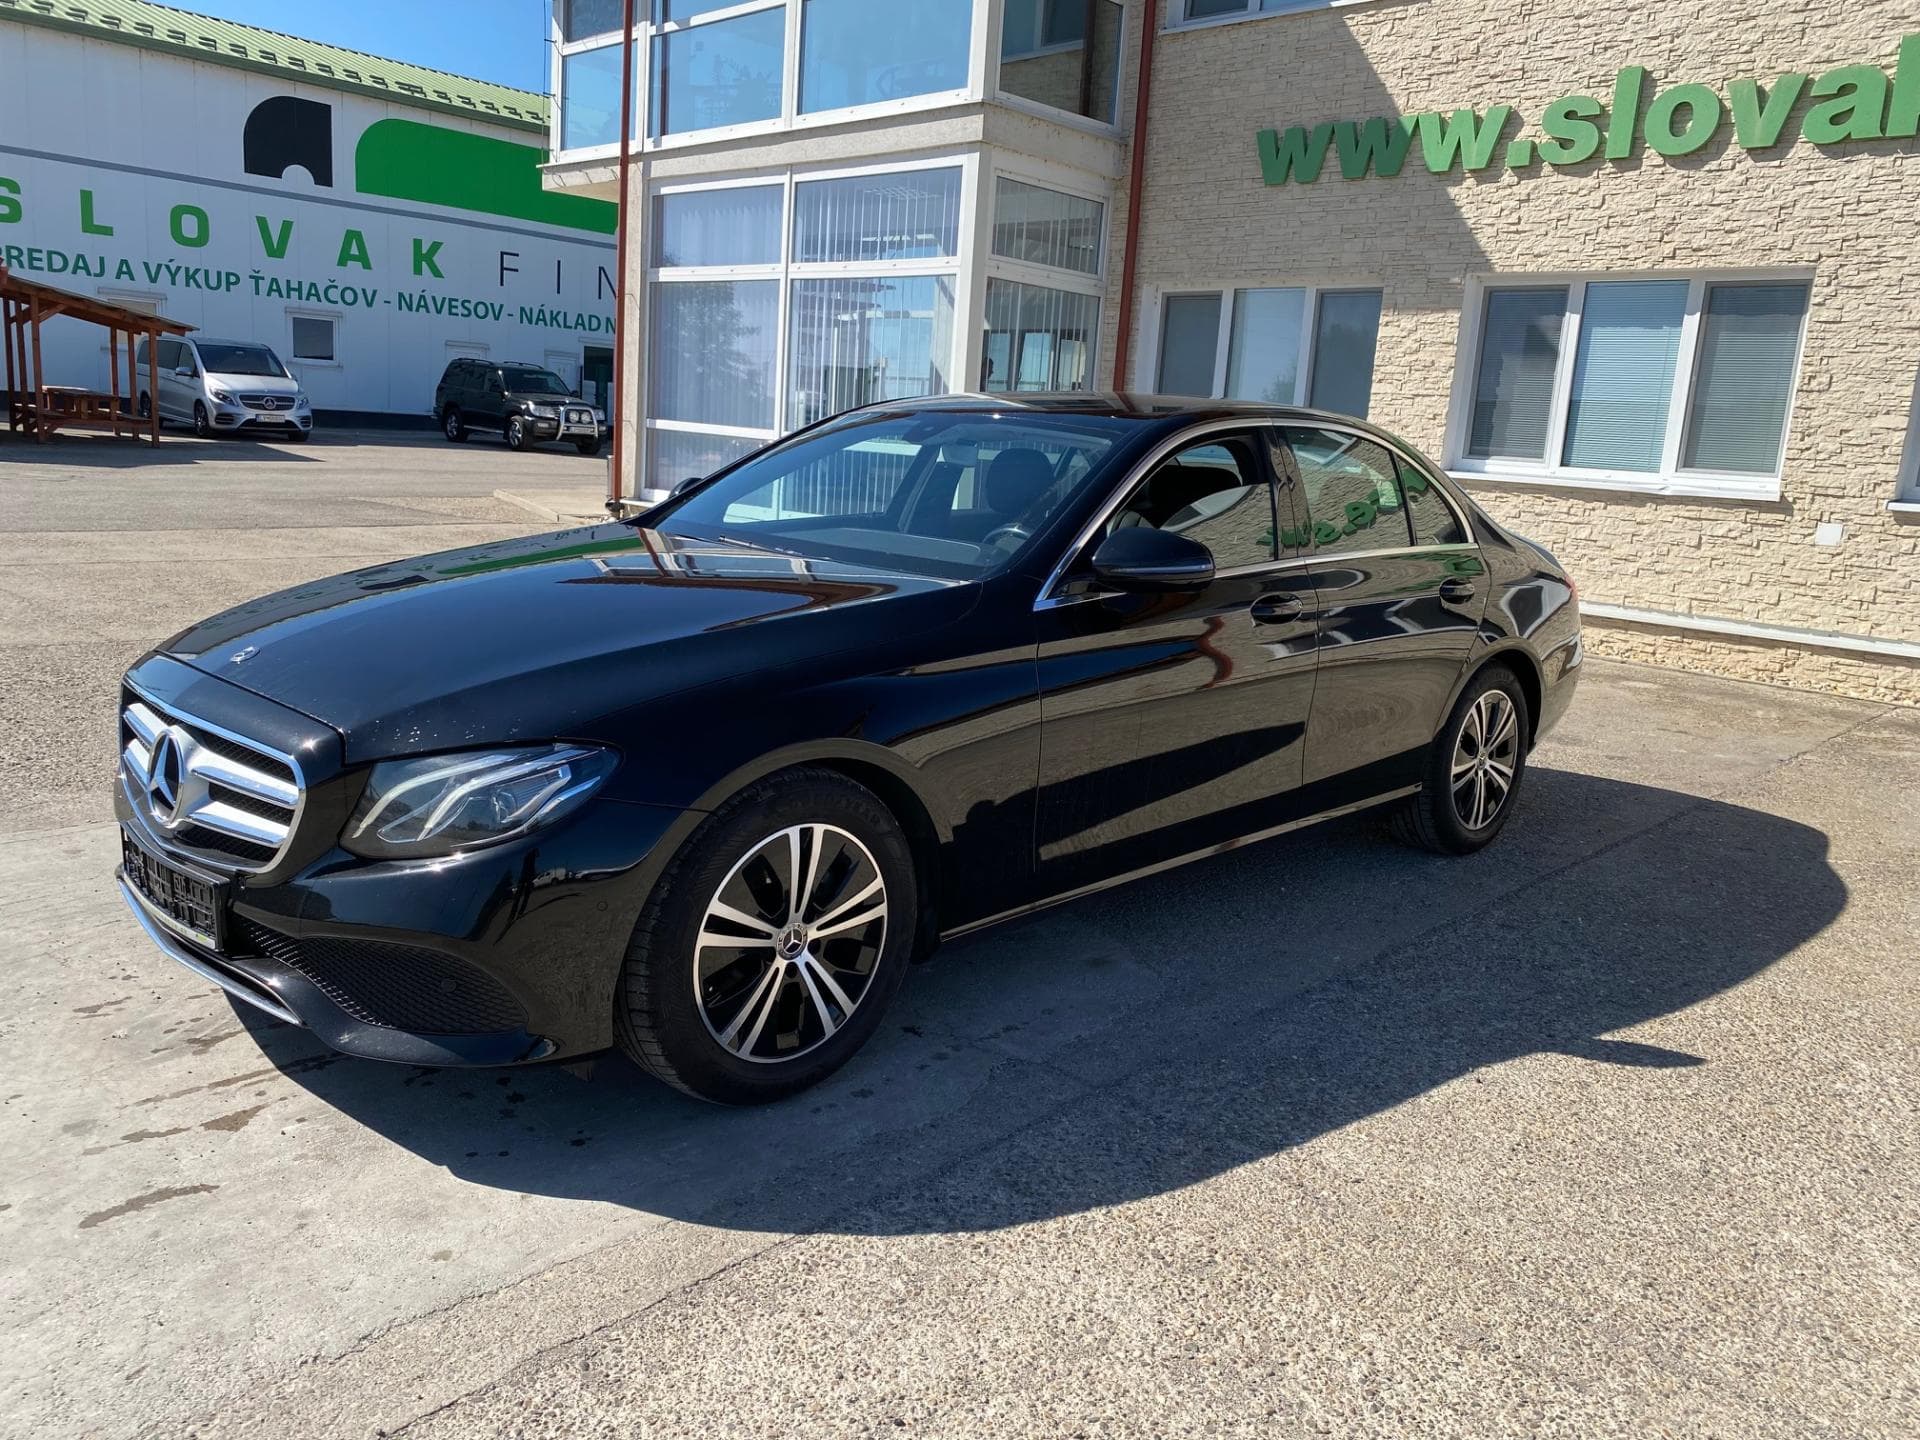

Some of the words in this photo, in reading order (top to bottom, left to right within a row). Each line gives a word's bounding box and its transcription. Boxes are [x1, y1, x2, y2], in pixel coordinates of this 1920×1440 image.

[0, 176, 445, 279] SLOVAK
[500, 250, 617, 300] FIN
[0, 244, 105, 278] REDAJ
[115, 258, 136, 282] A
[143, 258, 241, 293] VÝKUP
[249, 269, 378, 309] ŤAHAČOV
[398, 289, 504, 322] NÁVESOV
